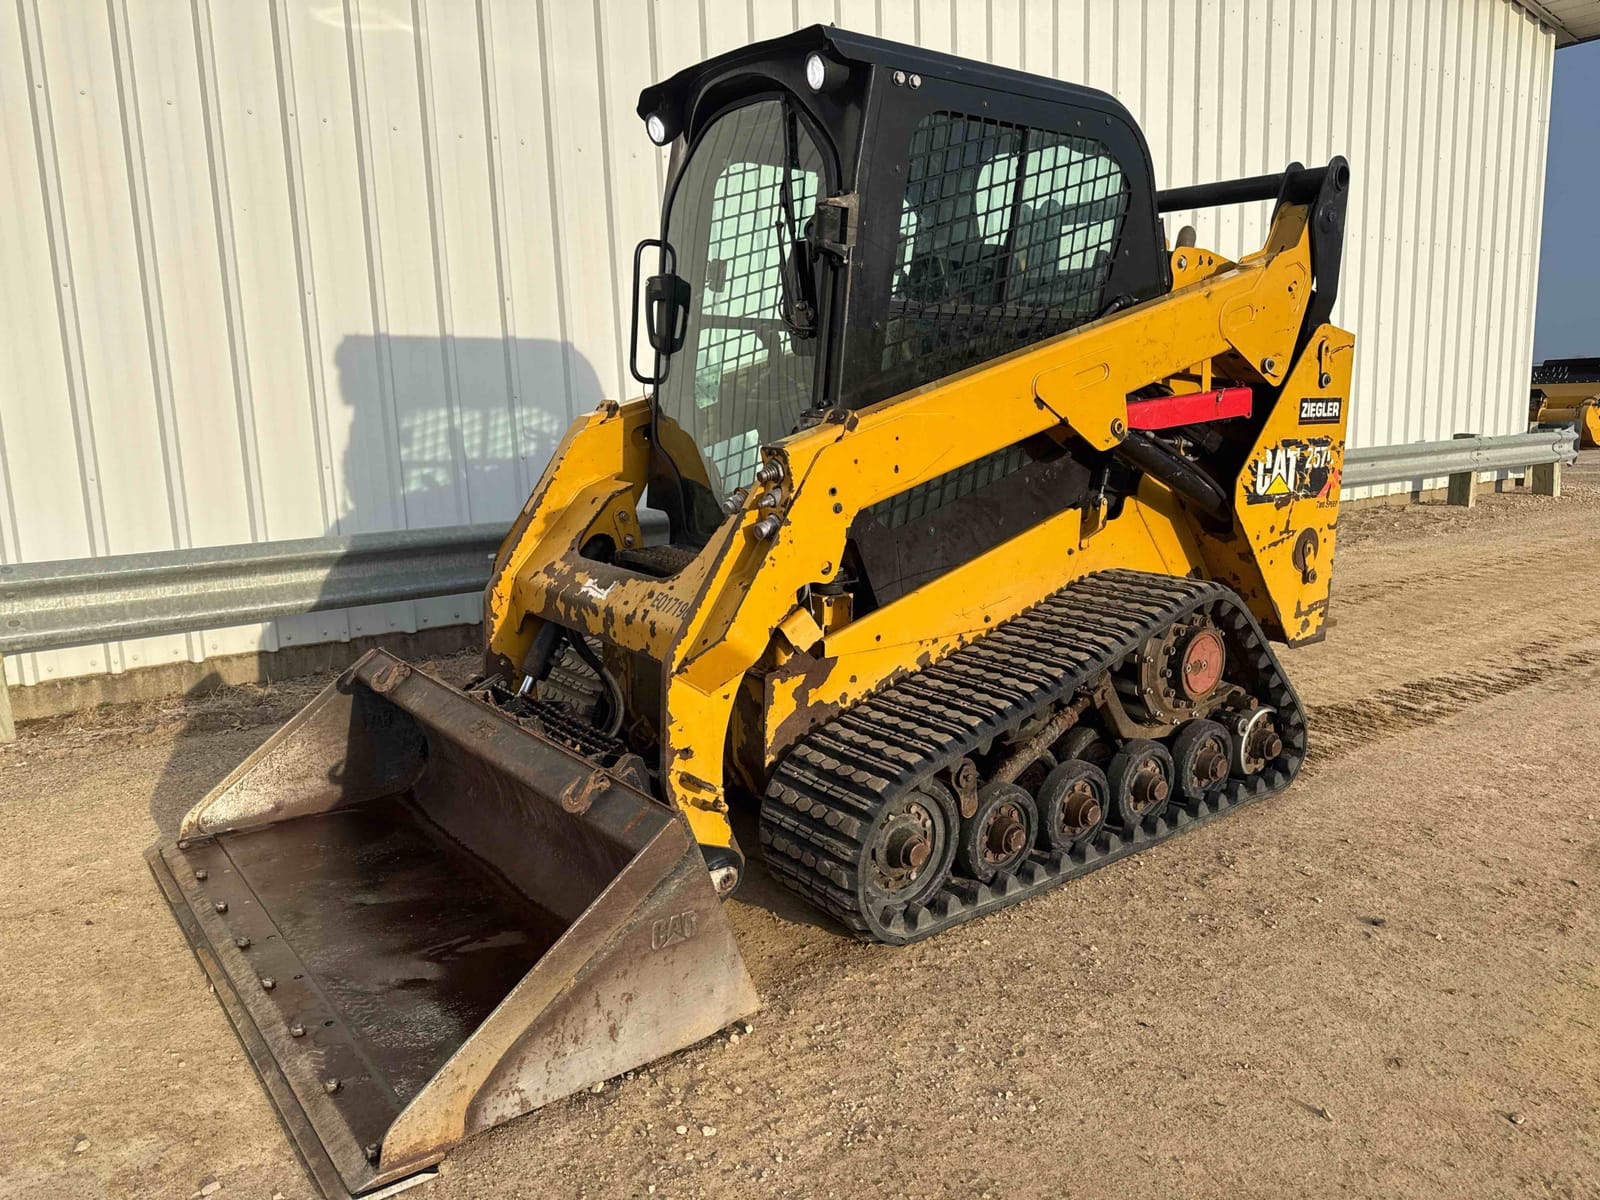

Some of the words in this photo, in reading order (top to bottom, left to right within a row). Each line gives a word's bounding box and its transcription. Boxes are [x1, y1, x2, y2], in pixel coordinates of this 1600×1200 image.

[1301, 402, 1340, 418] ZIEGLER
[1256, 448, 1300, 495] CAT
[651, 910, 697, 951] CAT
